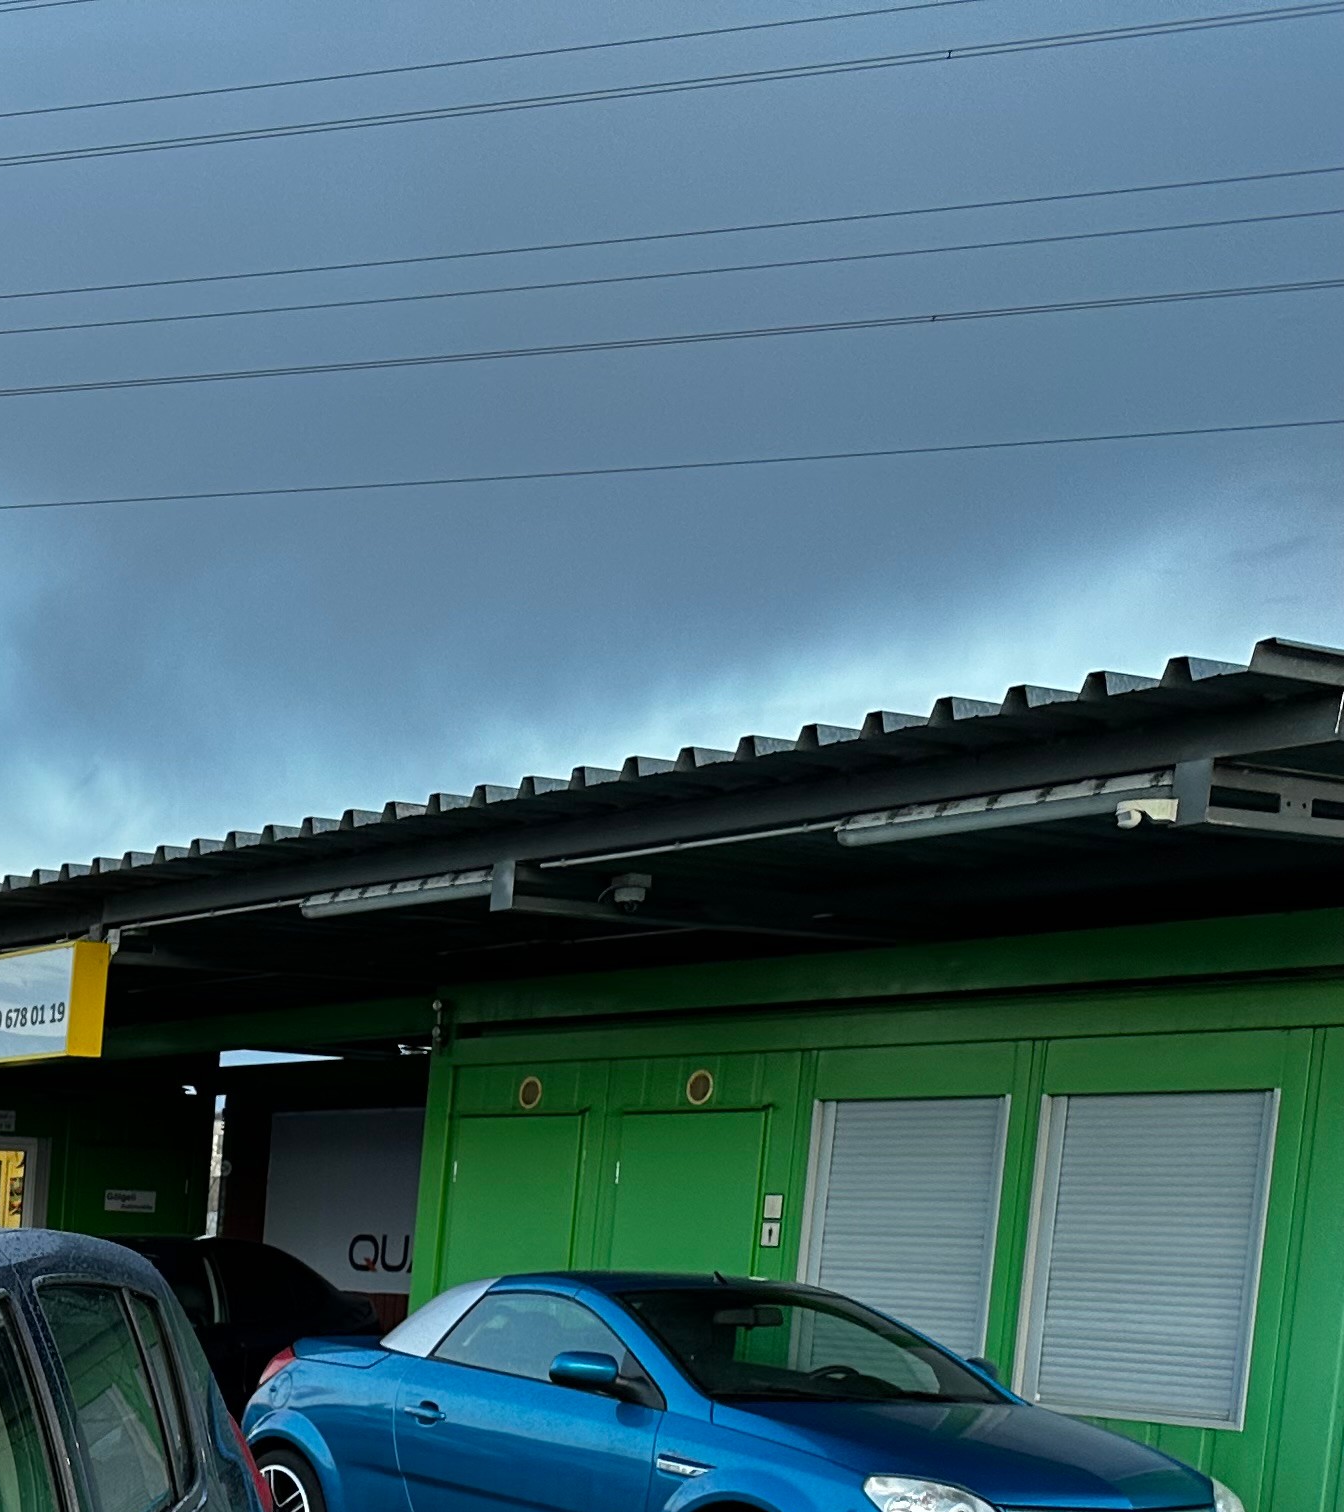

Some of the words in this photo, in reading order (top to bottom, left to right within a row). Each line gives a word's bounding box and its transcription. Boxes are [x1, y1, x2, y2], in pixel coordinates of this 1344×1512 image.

[5, 1007, 28, 1029] 678
[31, 1004, 45, 1026] 01
[49, 1002, 66, 1023] 19
[348, 1234, 413, 1273] QU
